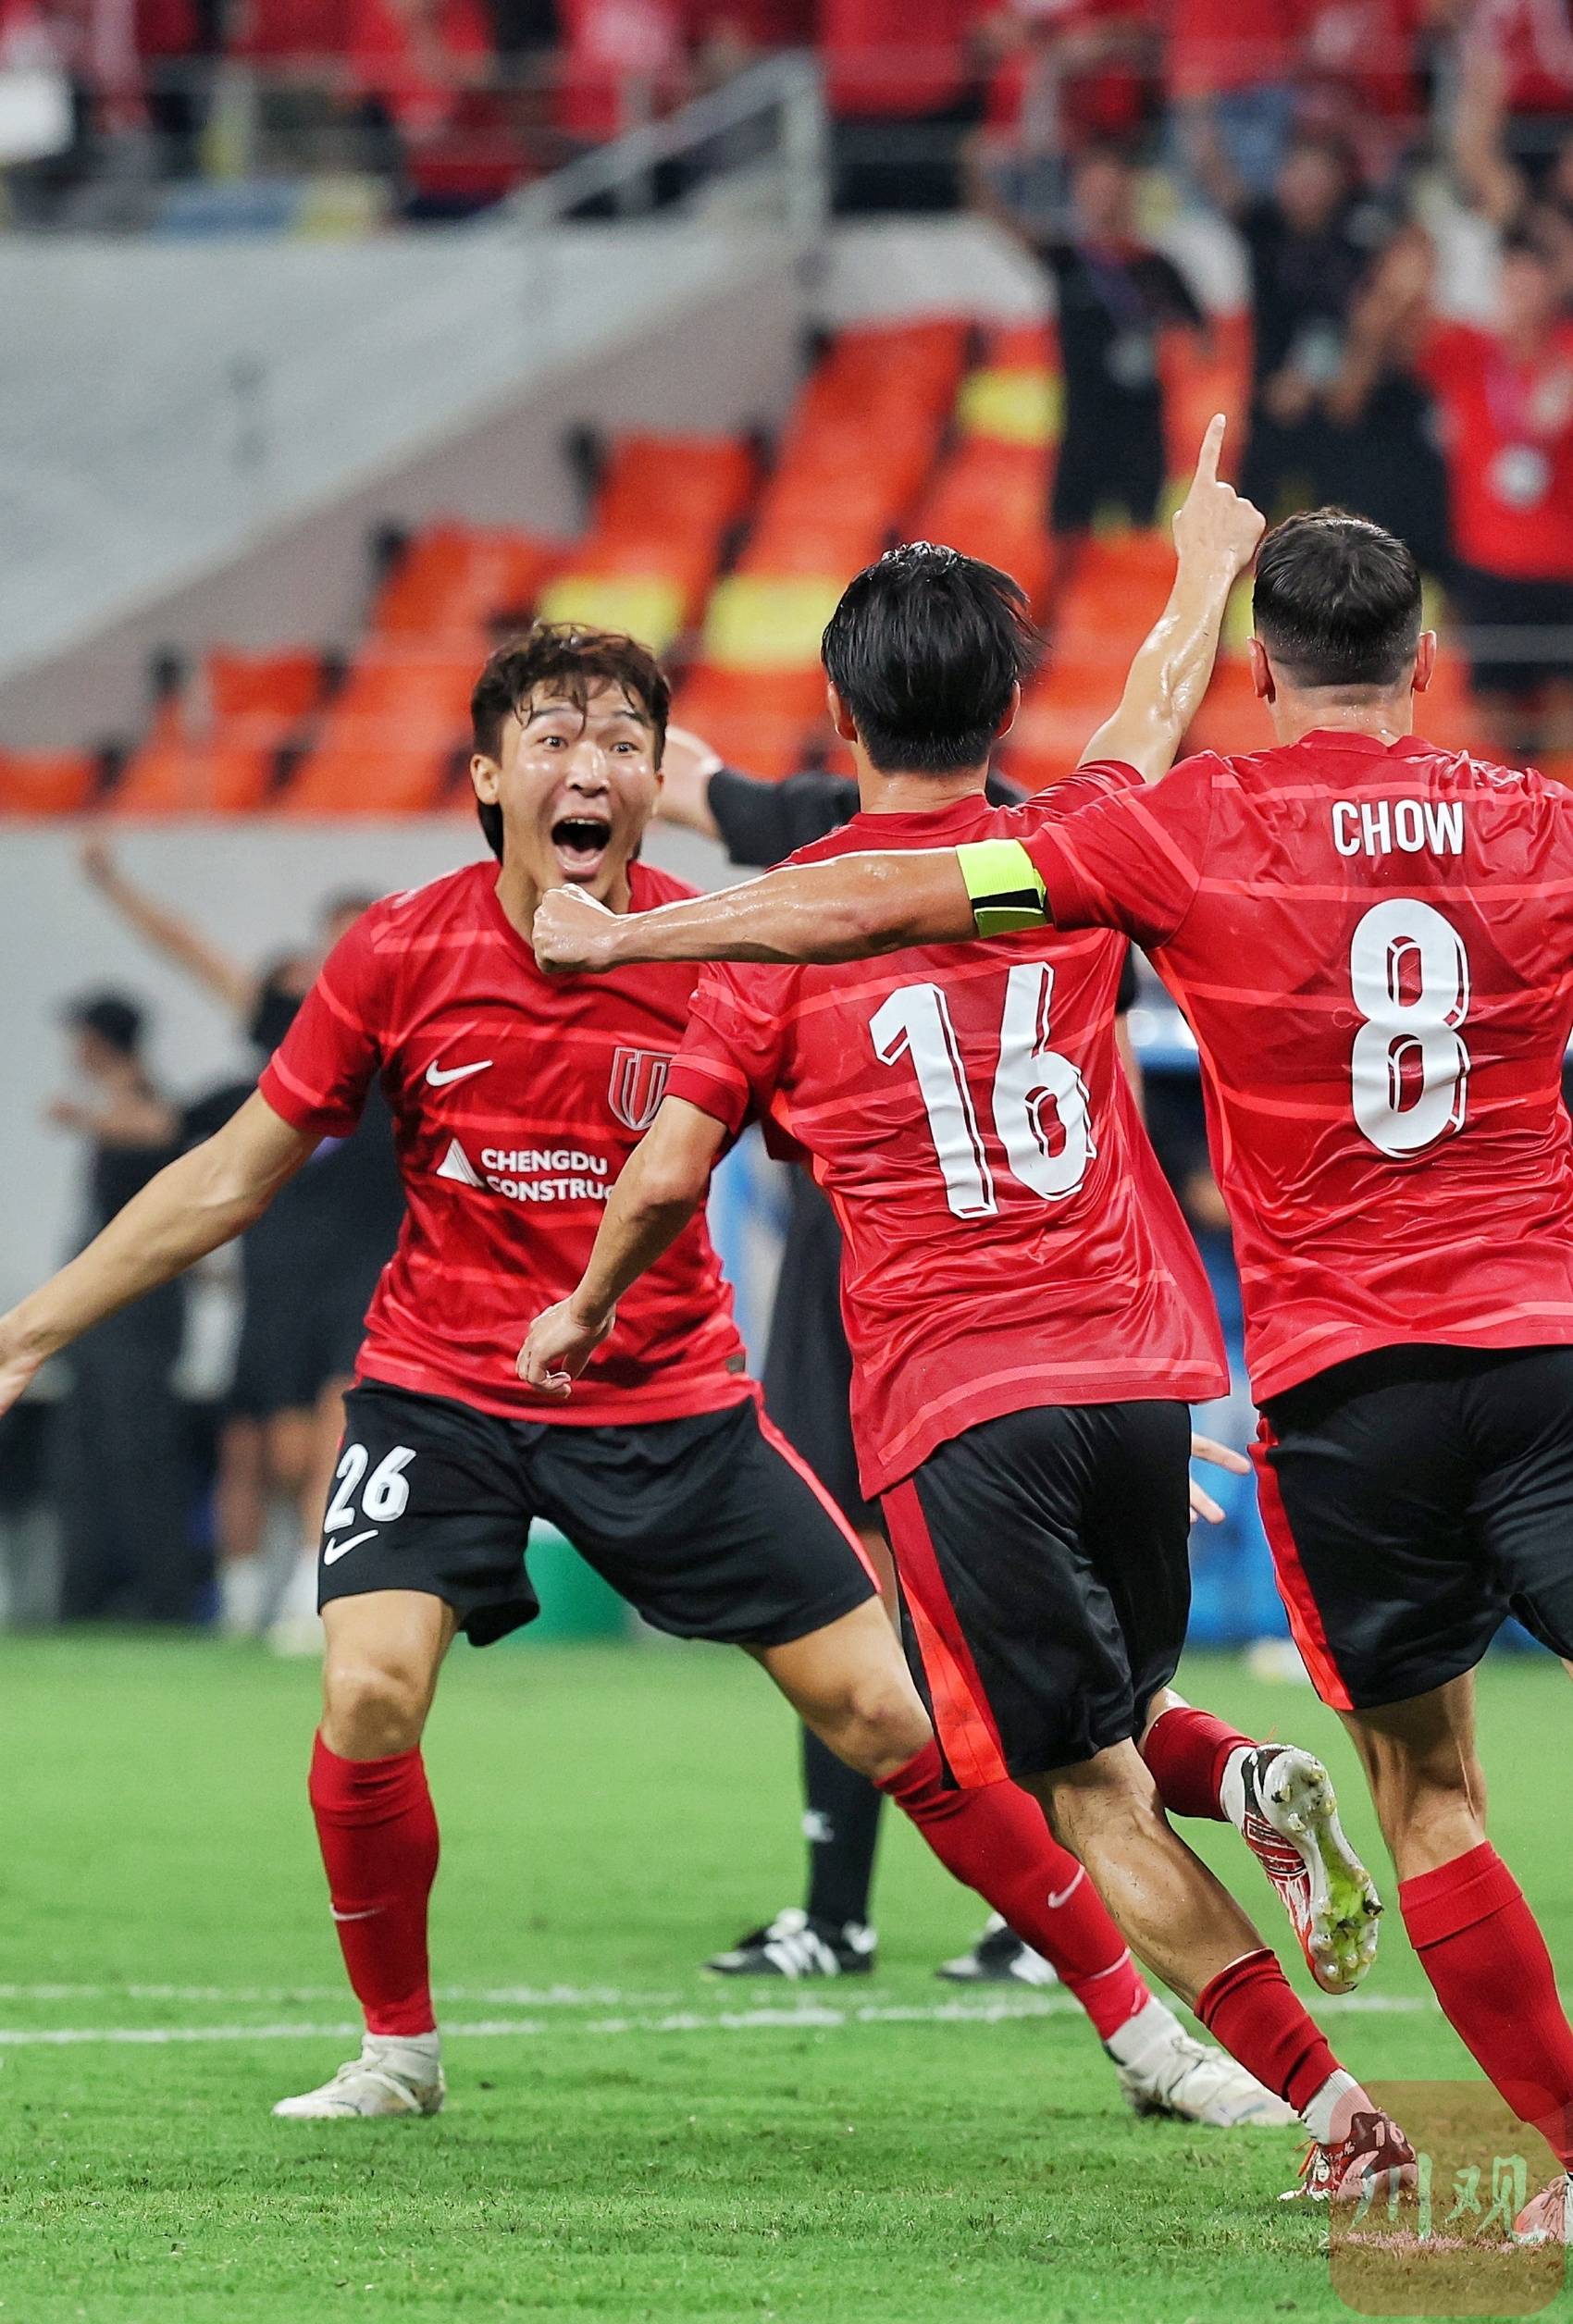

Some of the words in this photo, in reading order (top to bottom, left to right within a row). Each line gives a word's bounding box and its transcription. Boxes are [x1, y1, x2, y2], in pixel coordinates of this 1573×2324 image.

[1331, 799, 1464, 857] CHOW
[1350, 898, 1470, 1158] 8
[868, 960, 1097, 1219] 16
[481, 1147, 608, 1176] CHENGDU
[324, 1443, 416, 1534] 26
